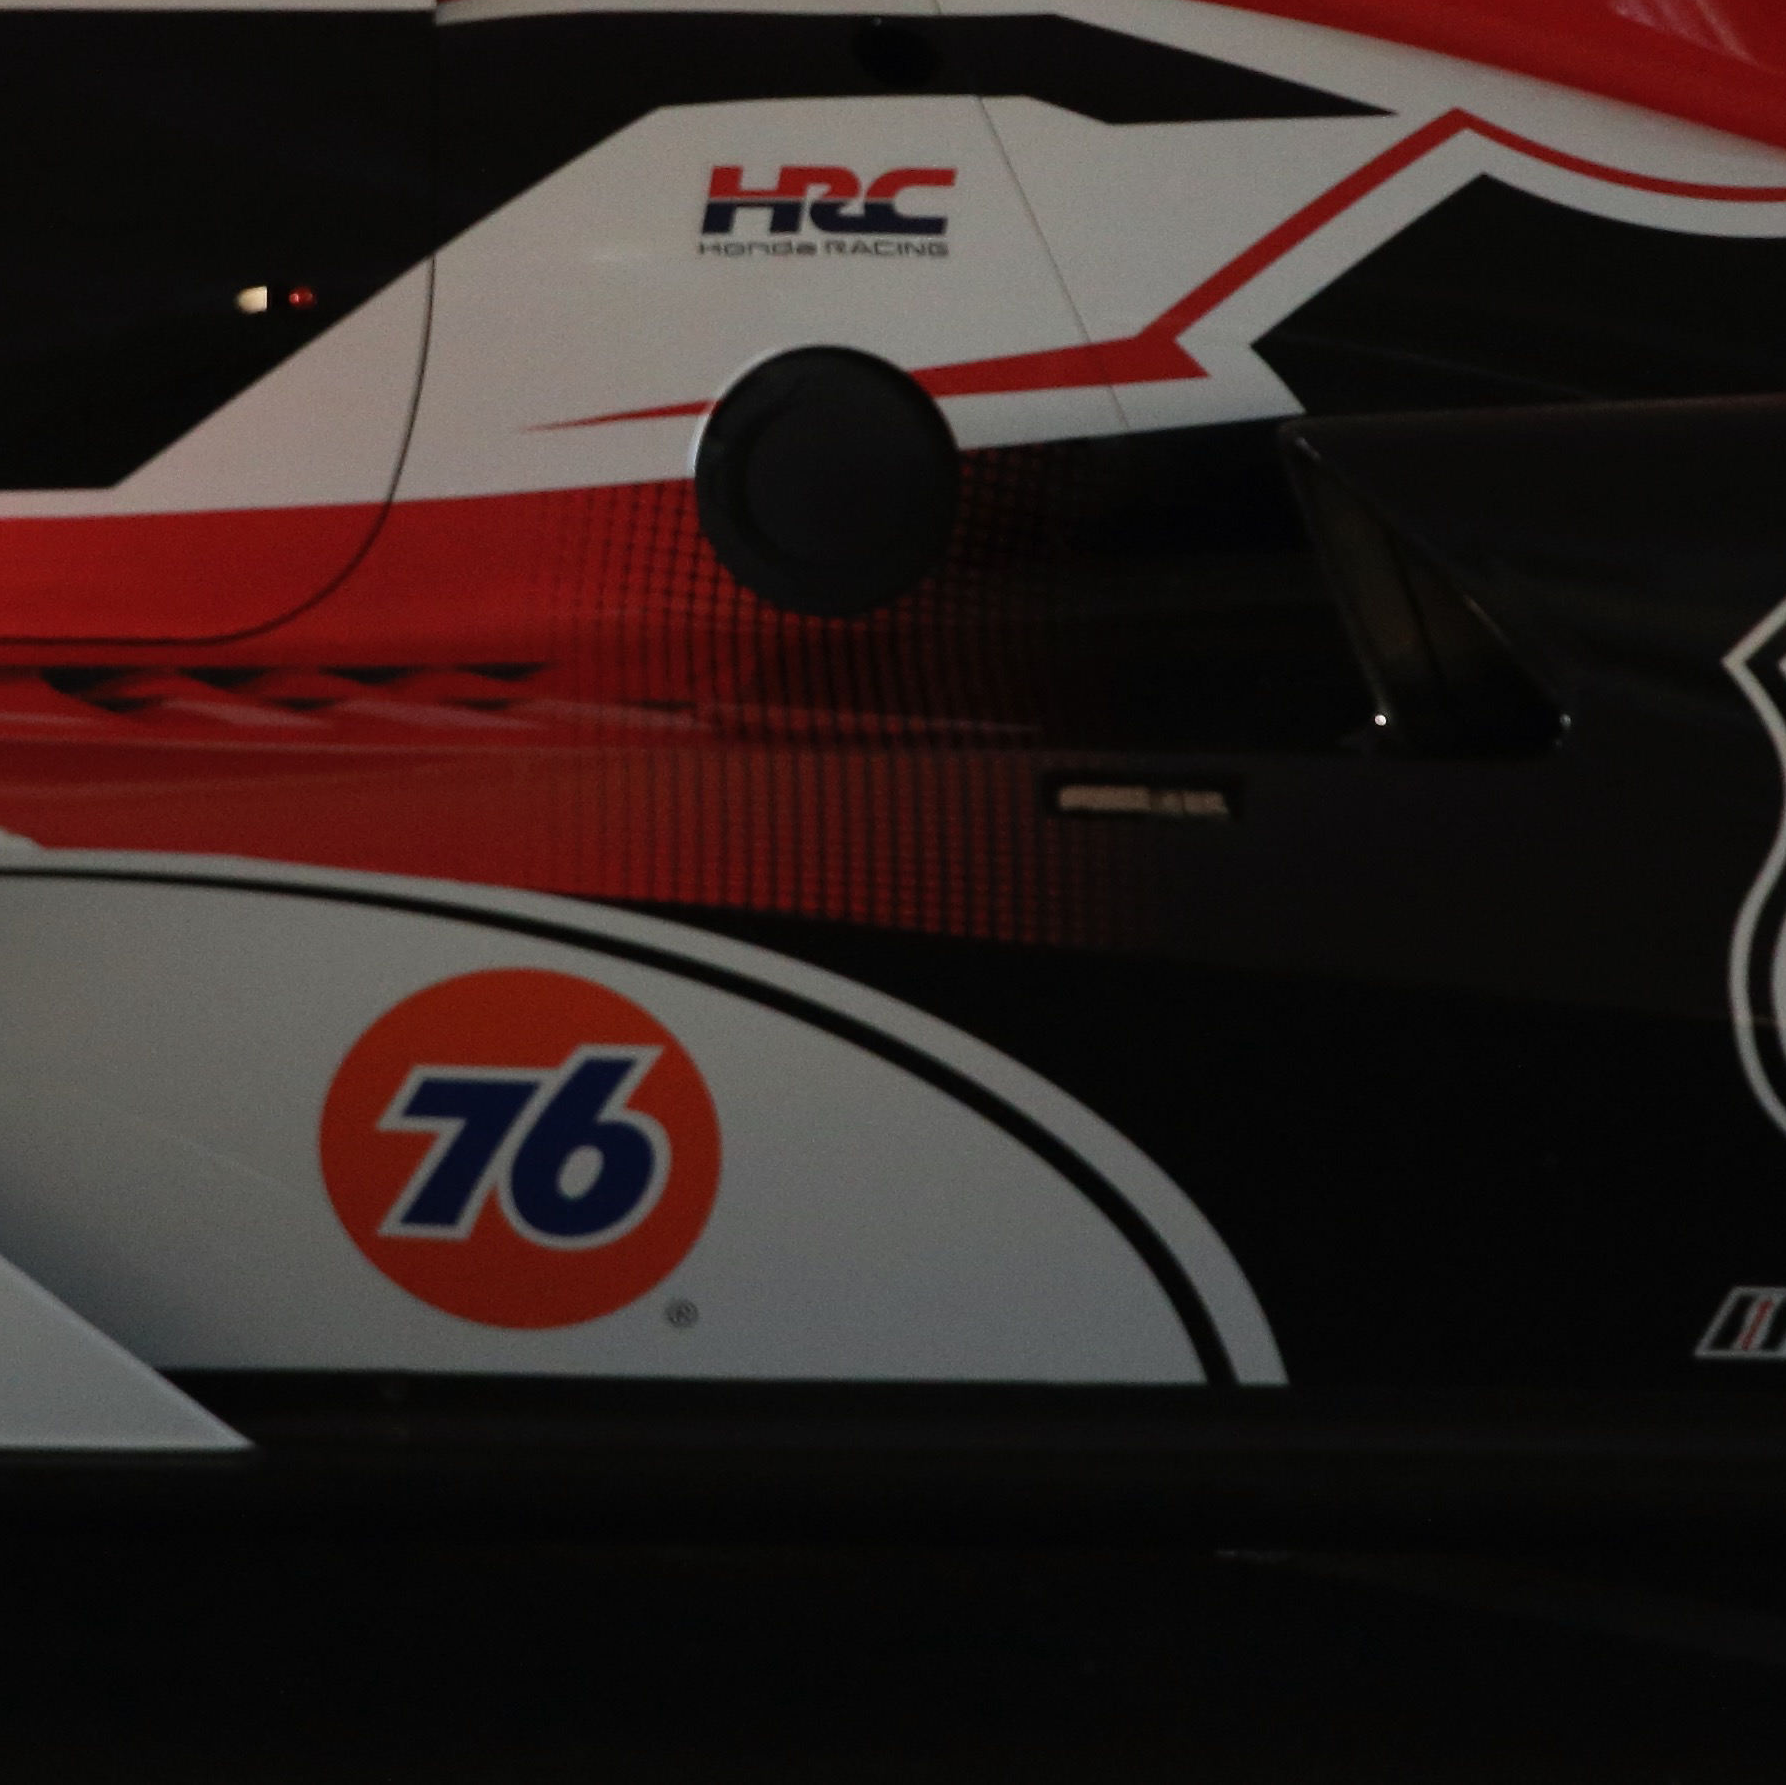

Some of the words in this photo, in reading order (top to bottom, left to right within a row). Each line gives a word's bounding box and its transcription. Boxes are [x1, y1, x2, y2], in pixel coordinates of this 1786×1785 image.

[701, 165, 958, 236] HRC
[697, 240, 815, 257] Honda
[825, 240, 950, 257] RACING
[375, 1042, 672, 1252] 76
